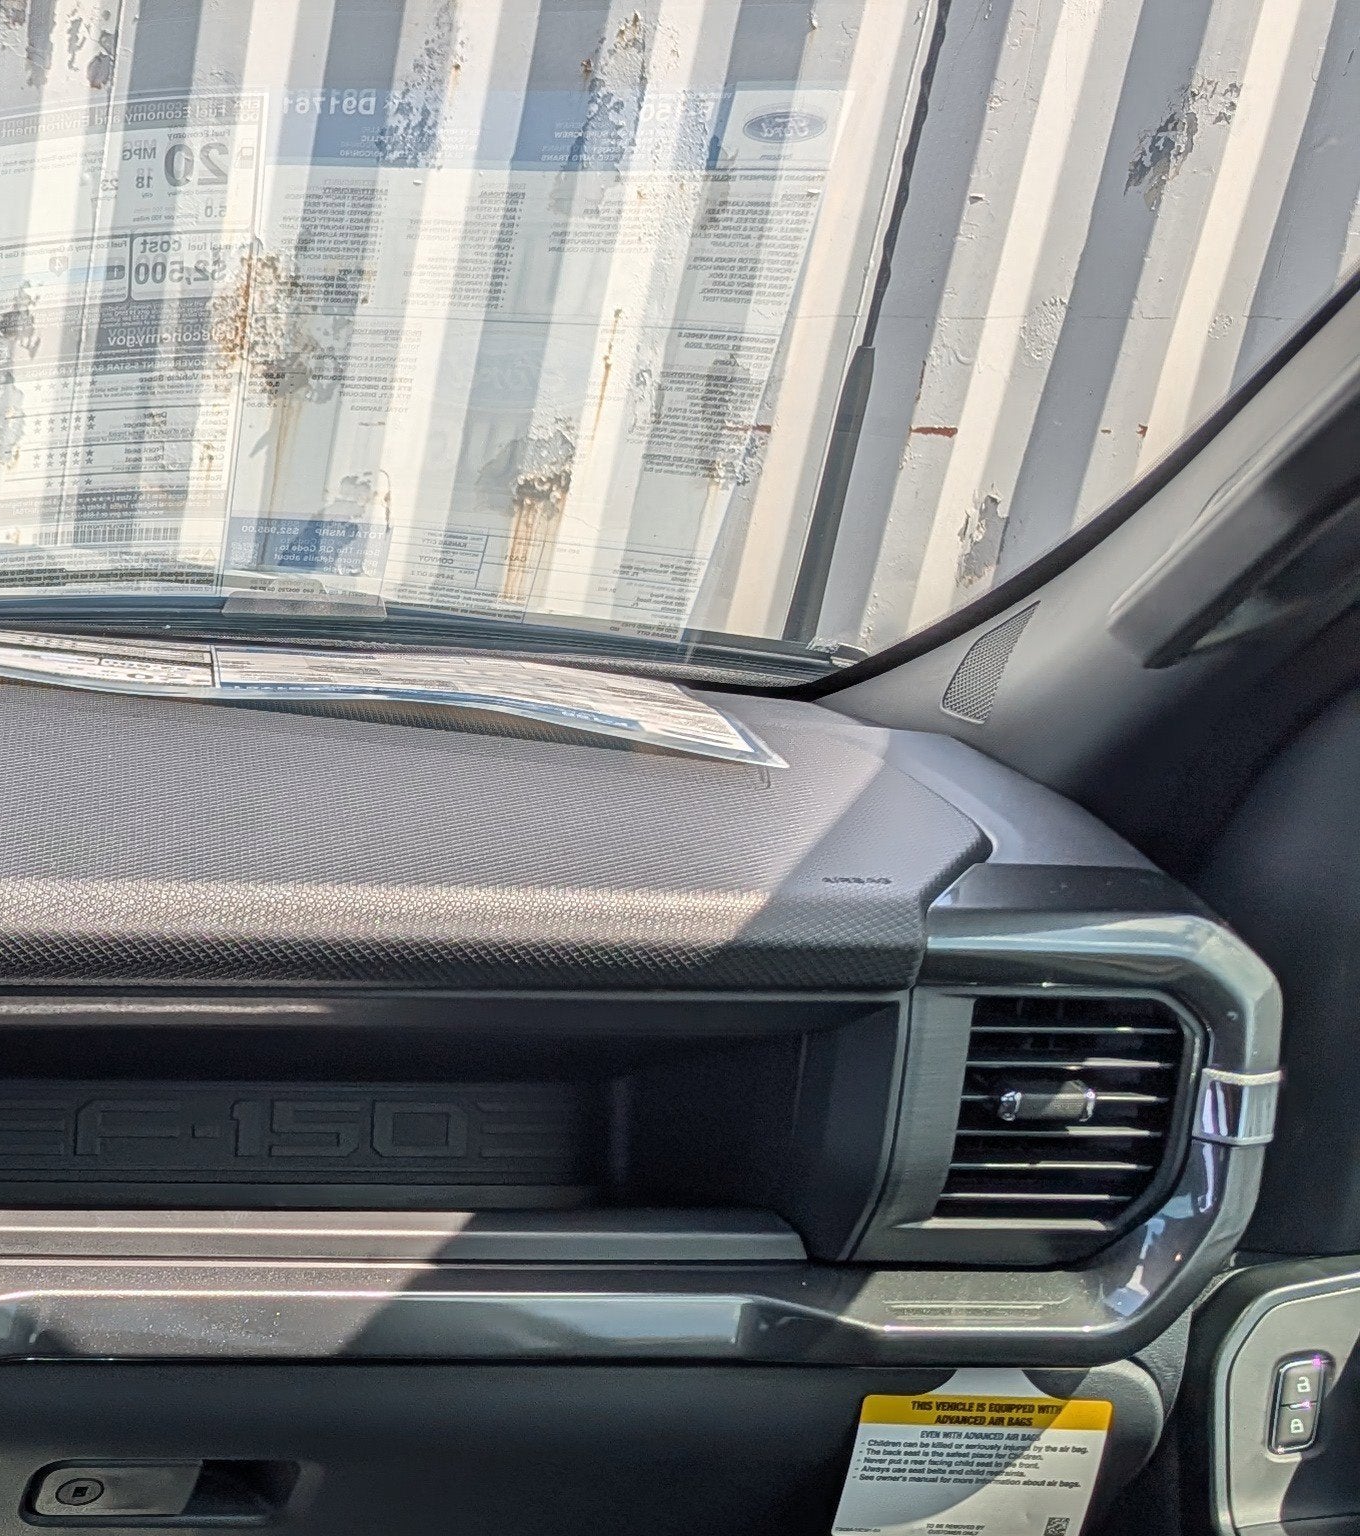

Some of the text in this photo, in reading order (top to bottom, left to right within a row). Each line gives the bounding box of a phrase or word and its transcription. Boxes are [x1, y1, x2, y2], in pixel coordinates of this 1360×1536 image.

[911, 1401, 933, 1411] THIS
[936, 1401, 975, 1412] VEHICLE
[977, 1402, 987, 1412] IS
[989, 1403, 1035, 1414] EQUIPPED
[935, 1415, 1033, 1427] ADVANCED AIR BAGS
[921, 1430, 941, 1439] EVEN
[963, 1432, 1005, 1441] ADVANCED
[1006, 1433, 1020, 1441] AIR
[868, 1440, 902, 1448] Children
